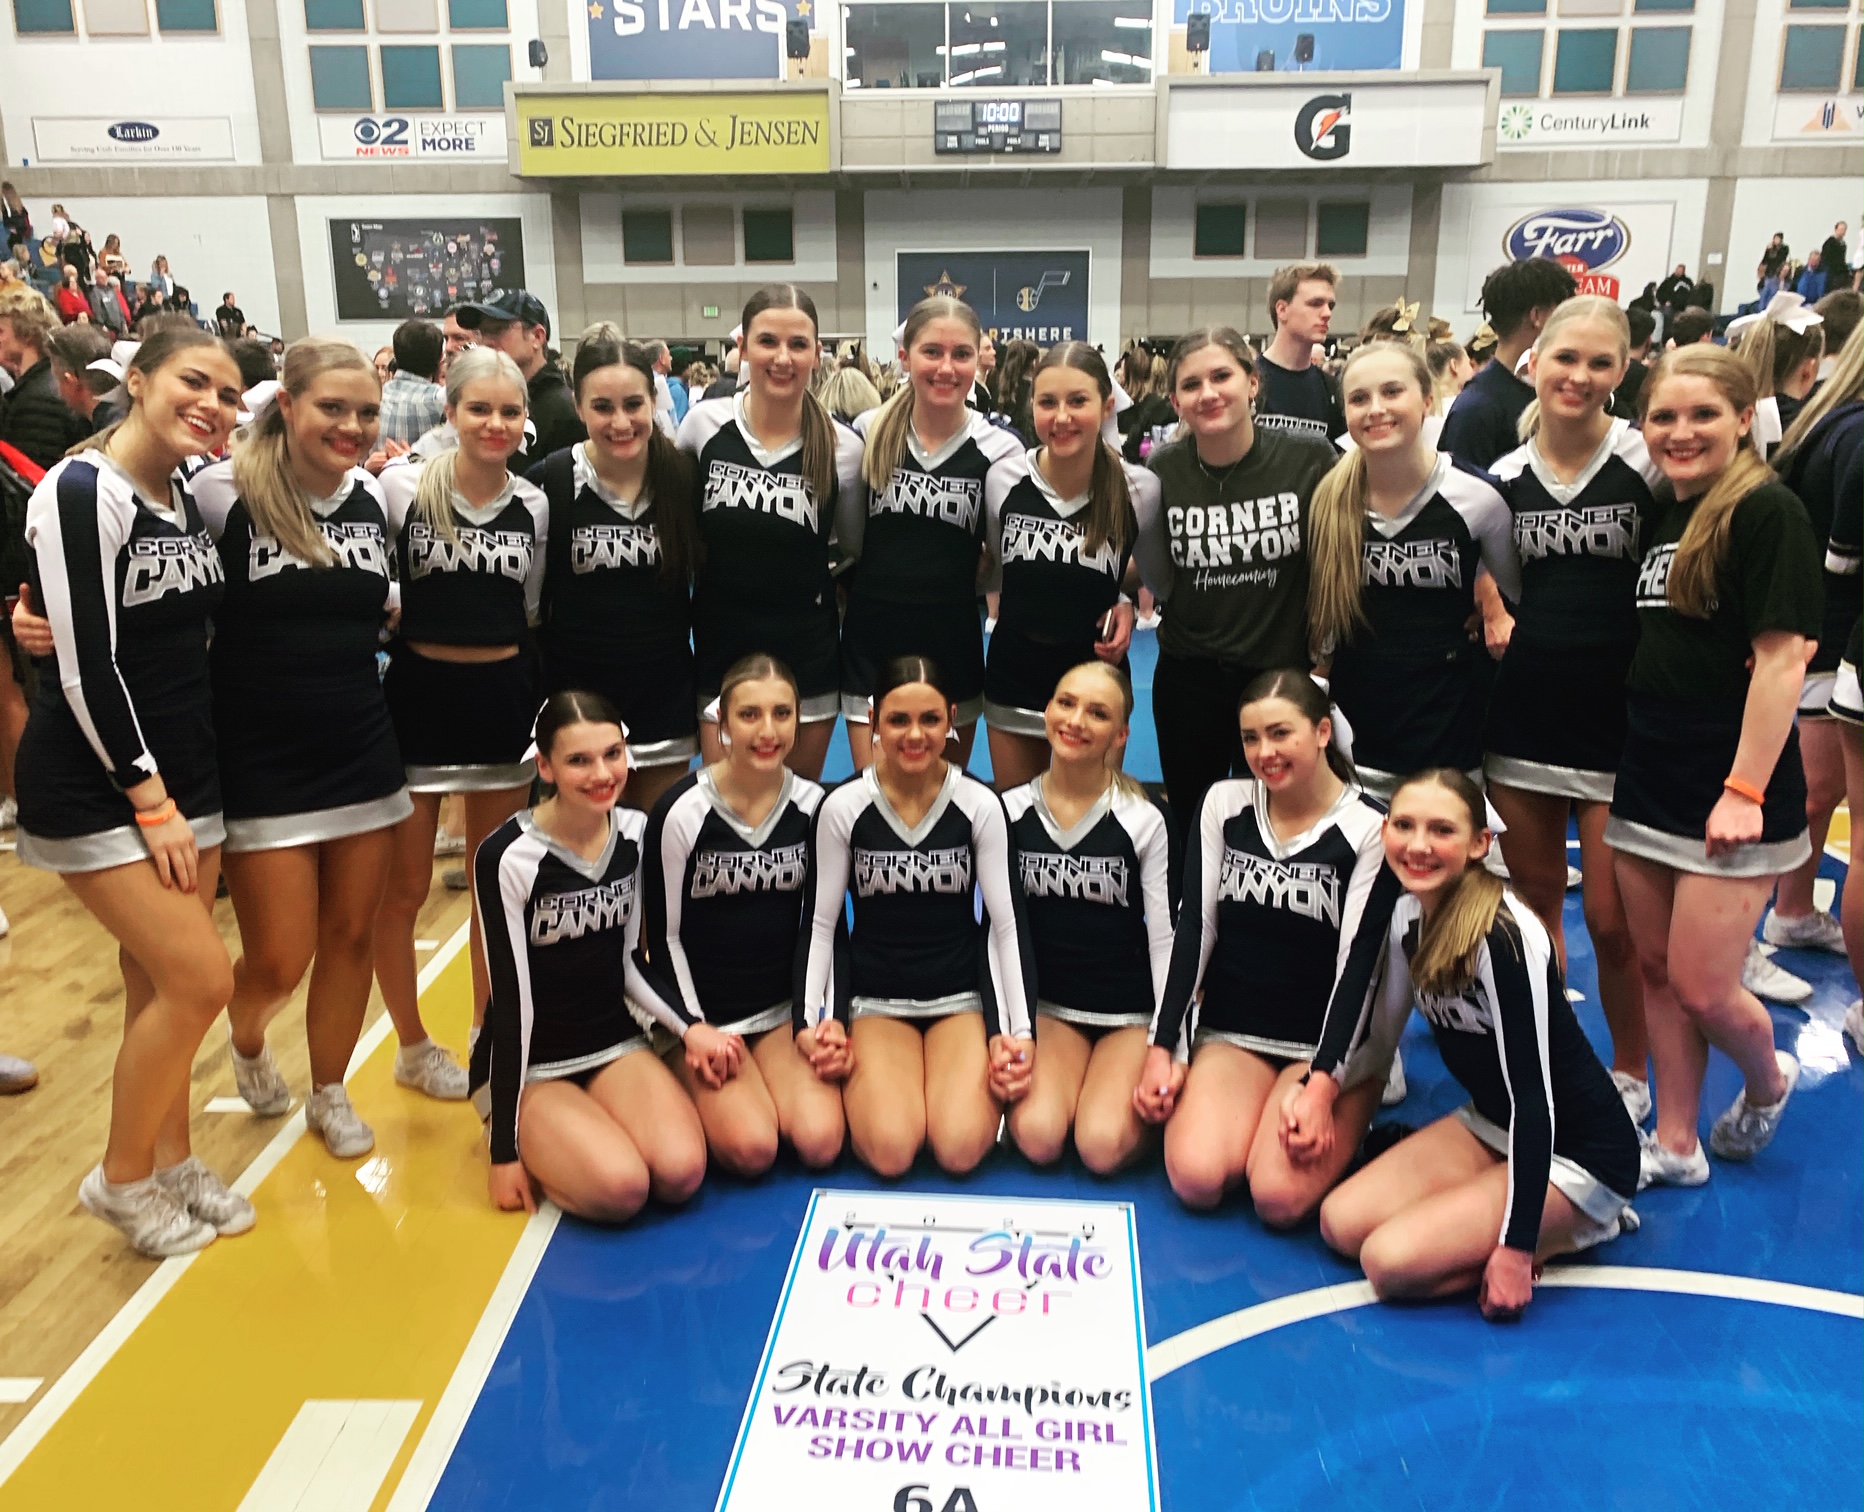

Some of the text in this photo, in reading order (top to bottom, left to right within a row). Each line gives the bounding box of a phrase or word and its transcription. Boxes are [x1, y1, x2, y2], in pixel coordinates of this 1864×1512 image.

[613, 0, 787, 36] STARS
[983, 102, 1020, 122] 10:00
[1540, 112, 1650, 132] CenturyLink
[114, 125, 153, 139] Larkin
[380, 118, 409, 145] 2
[420, 121, 486, 136] EXPECT
[421, 138, 476, 151] MORE
[560, 114, 820, 150] SIEGFRIED & JENSEN
[355, 147, 410, 156] NEWS
[1523, 211, 1615, 258] Farr
[891, 467, 982, 496] ORNER
[703, 478, 818, 535] CANYON
[1167, 491, 1300, 537] CORNER
[1515, 502, 1640, 530] ORNER
[573, 524, 656, 541] CORN
[1005, 513, 1084, 537] CORN
[571, 538, 663, 575] CANY
[1170, 523, 1300, 568] CANYON
[1364, 539, 1458, 561] RNER
[1514, 516, 1641, 567] ANYON
[1192, 567, 1281, 592] Homecoming
[1361, 555, 1462, 589] NYON
[855, 844, 970, 871] CORNER
[1019, 850, 1129, 874] ORNER
[855, 856, 971, 898] CANYON
[1020, 866, 1129, 908] ANYON
[817, 1227, 1113, 1284] Utah State
[846, 1279, 1073, 1317] cheer
[772, 1358, 1132, 1417] State Champions
[773, 1402, 1129, 1447] VARSITY ALL GIRL
[807, 1434, 1082, 1473] SHOW CHEER
[893, 1482, 979, 1512] 6A
